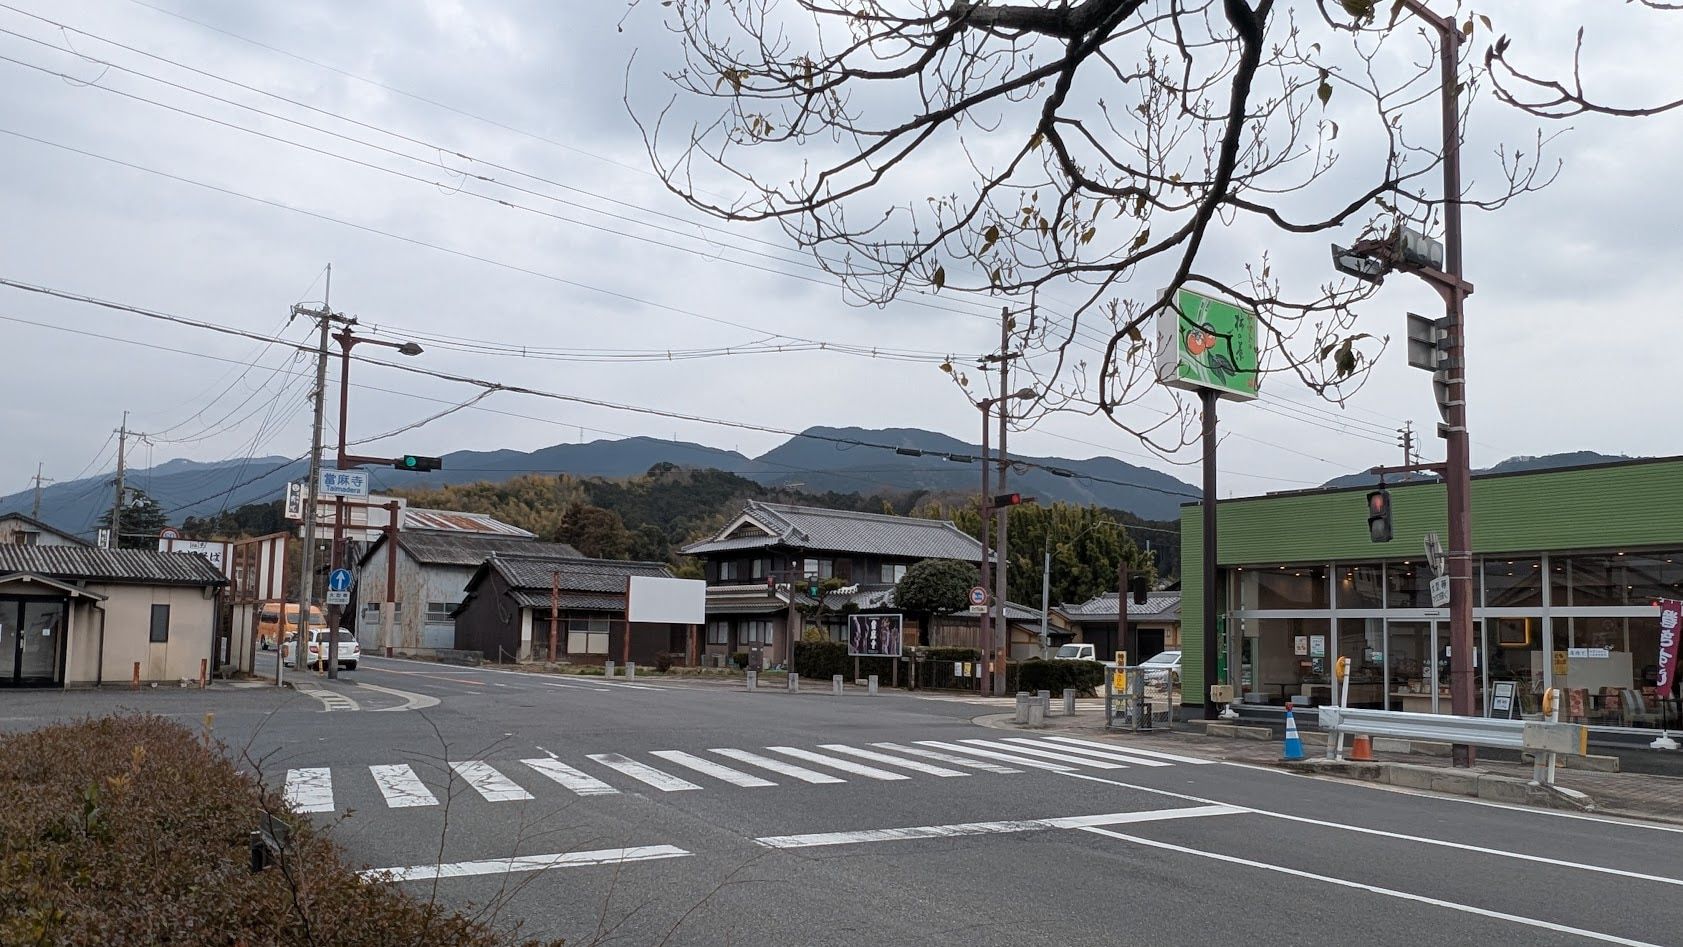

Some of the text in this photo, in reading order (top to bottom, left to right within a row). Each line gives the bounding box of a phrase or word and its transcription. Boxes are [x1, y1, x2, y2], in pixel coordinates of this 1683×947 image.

[324, 473, 364, 488] 當麻寺
[326, 485, 361, 494] Taimadera
